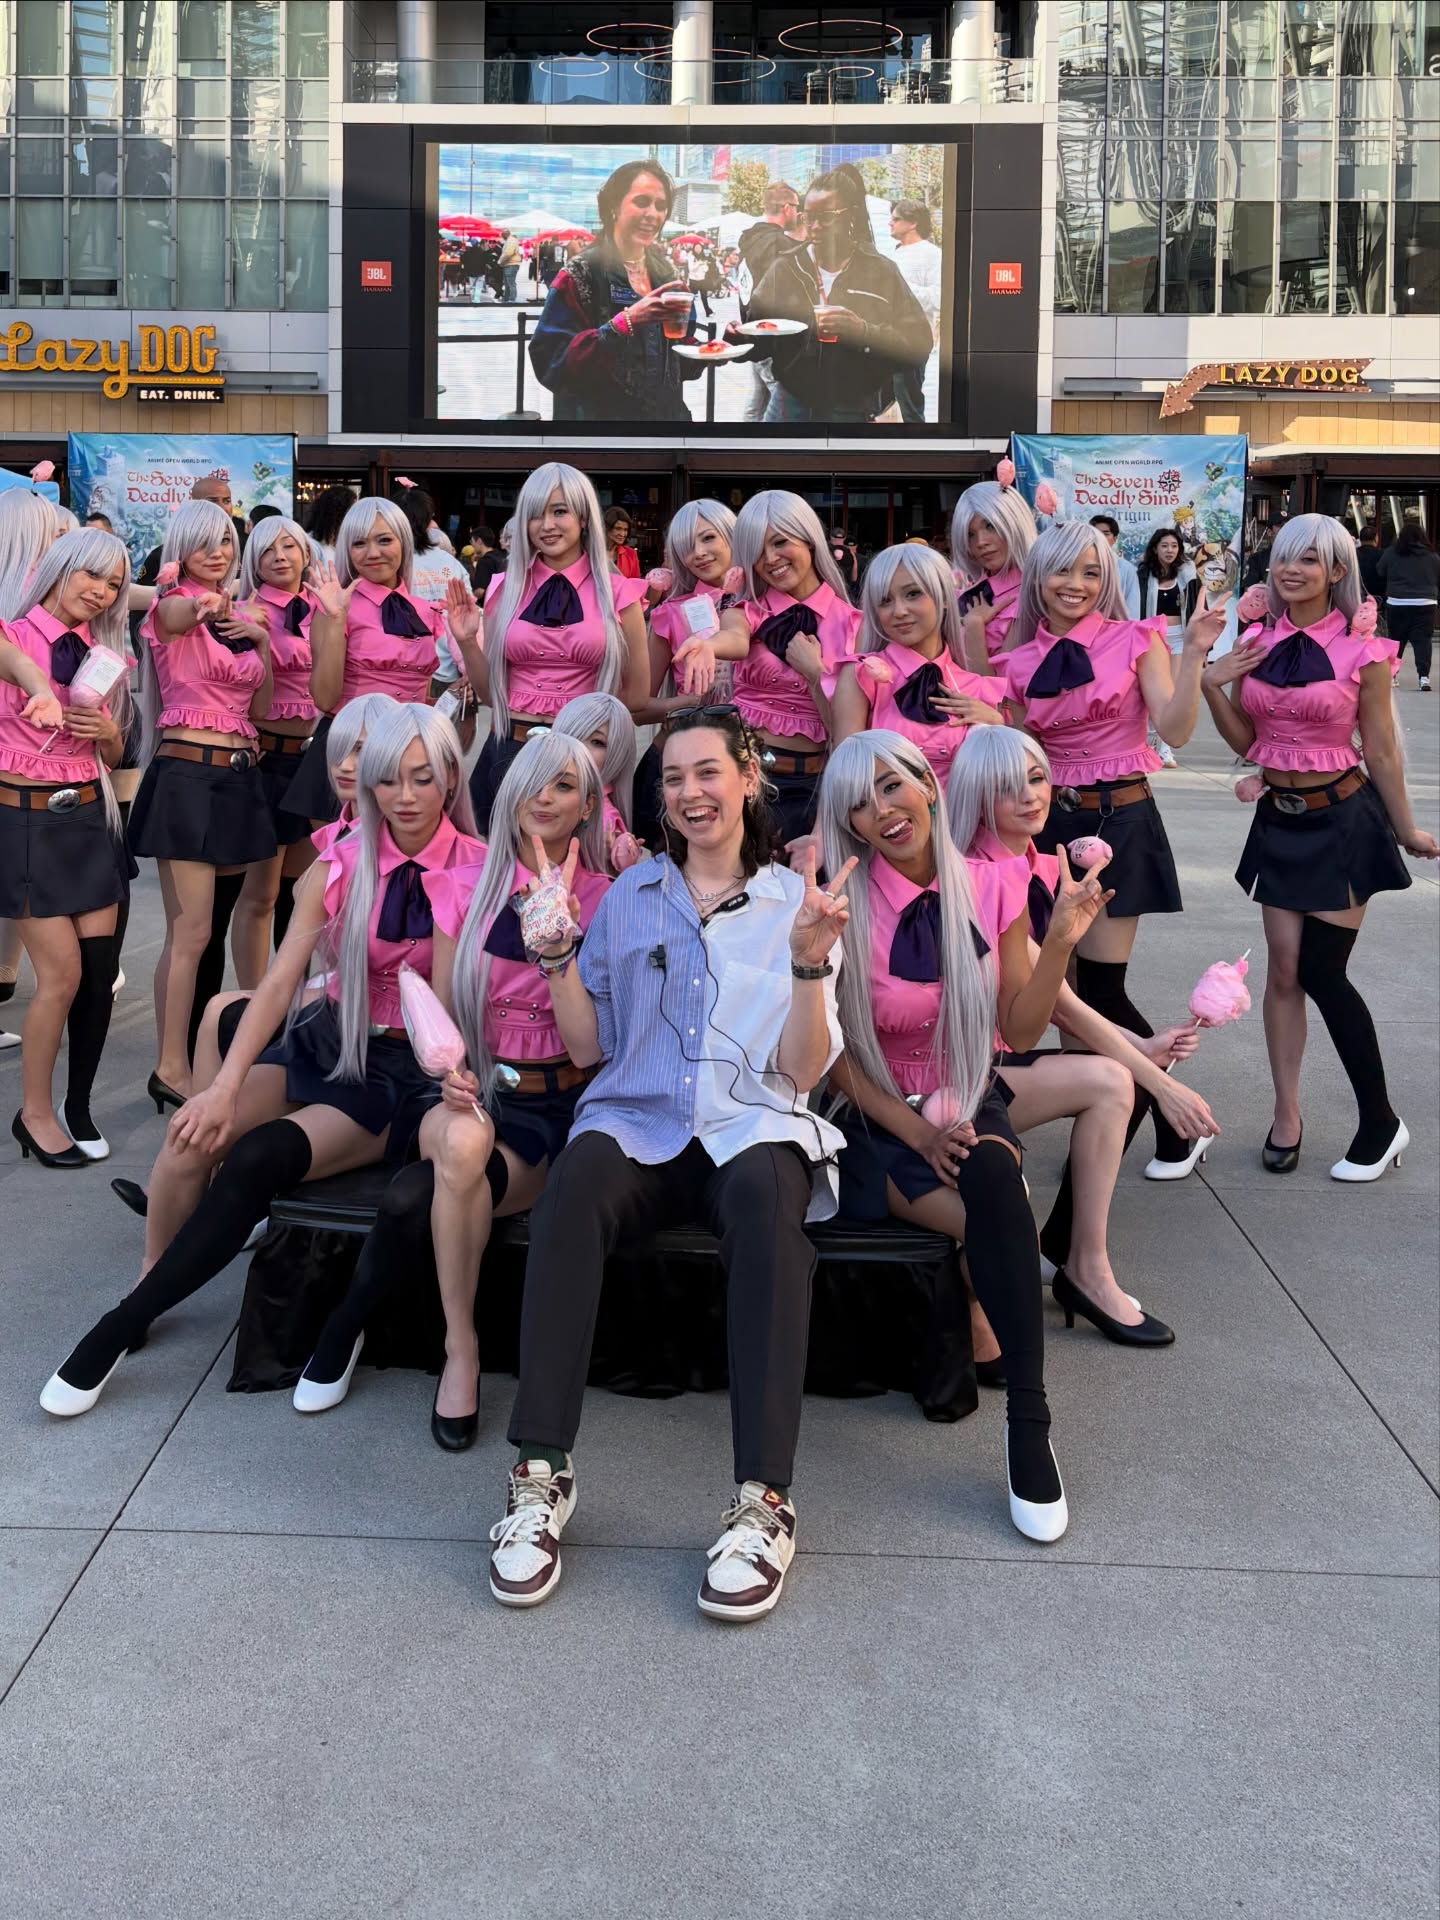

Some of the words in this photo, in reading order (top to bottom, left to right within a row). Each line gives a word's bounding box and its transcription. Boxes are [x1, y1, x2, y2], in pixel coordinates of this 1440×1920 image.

[367, 268, 386, 280] JBL
[995, 270, 1015, 282] JBL
[0, 321, 130, 399] Lazy
[138, 324, 220, 373] DOG
[1220, 364, 1291, 384] LAZY
[1301, 366, 1360, 384] DOG
[140, 389, 169, 400] EAT.
[174, 390, 220, 400] DRINK.
[127, 471, 149, 484] The
[1074, 473, 1098, 486] The
[1099, 472, 1154, 489] Seven
[127, 487, 186, 504] Deadly
[1074, 489, 1136, 509] Deadly
[1138, 489, 1180, 506] Sins
